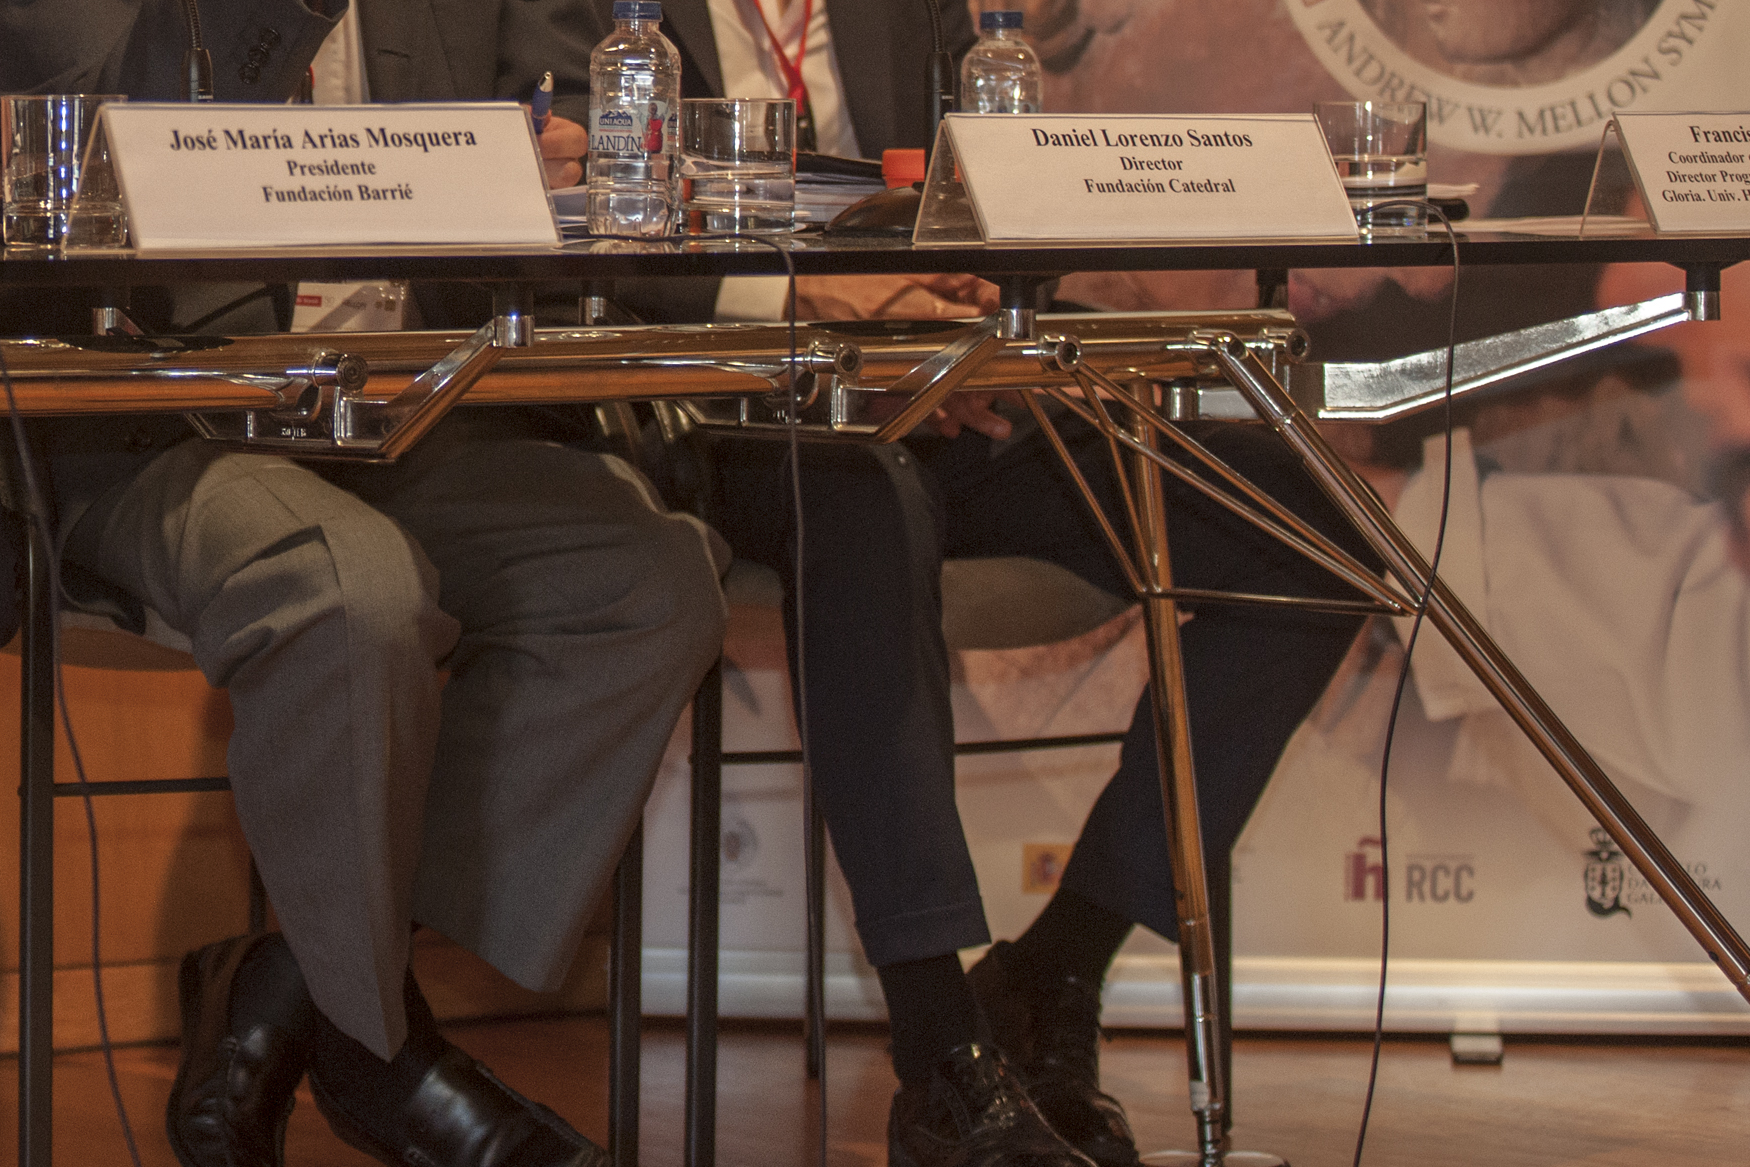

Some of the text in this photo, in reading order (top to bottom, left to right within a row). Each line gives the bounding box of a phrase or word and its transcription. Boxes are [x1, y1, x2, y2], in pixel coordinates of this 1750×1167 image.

[1515, 57, 1663, 140] MELLON
[169, 127, 478, 153] José María Arias Mosquera
[591, 134, 642, 152] LANDÍN
[1031, 128, 1254, 148] Daniel Lorenzo Santos
[1119, 155, 1184, 172] Director
[1667, 151, 1746, 164] Coordinador
[285, 159, 377, 177] Presidente
[1665, 170, 1718, 183] Director
[261, 182, 414, 203] Fundación Barrié
[1083, 178, 1237, 194] Fundación Catedral
[1661, 189, 1706, 203] Gloria.
[1706, 189, 1742, 203] Univ.
[1405, 863, 1475, 904] RCC
